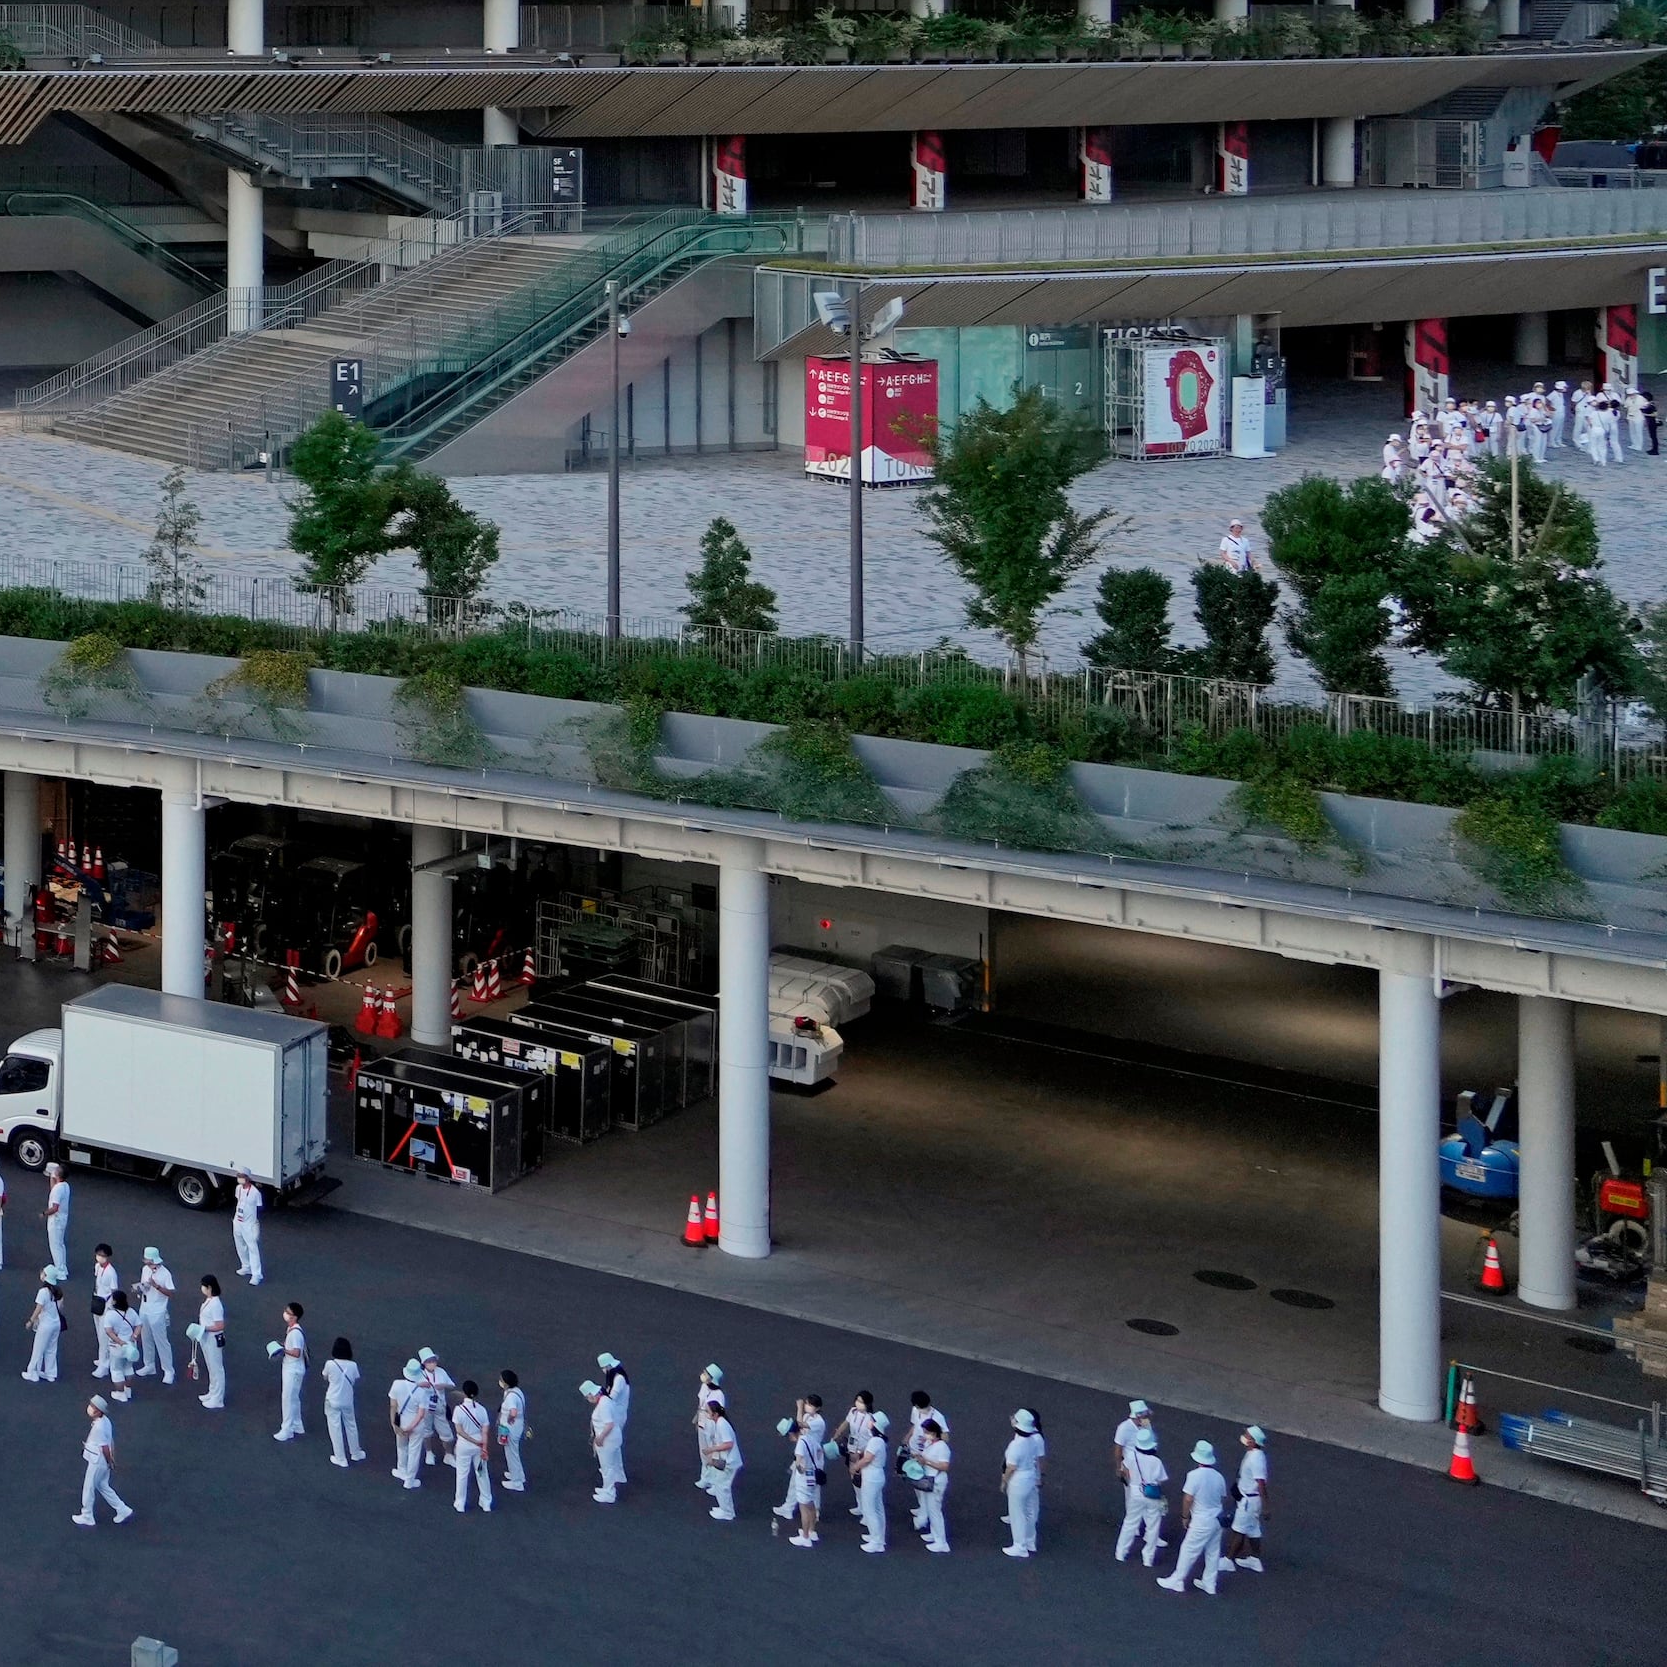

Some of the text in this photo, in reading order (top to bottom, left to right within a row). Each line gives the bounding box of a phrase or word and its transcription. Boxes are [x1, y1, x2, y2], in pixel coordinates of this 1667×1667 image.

[337, 362, 359, 382] E1
[1074, 381, 1083, 395] 2
[816, 450, 850, 475] 202
